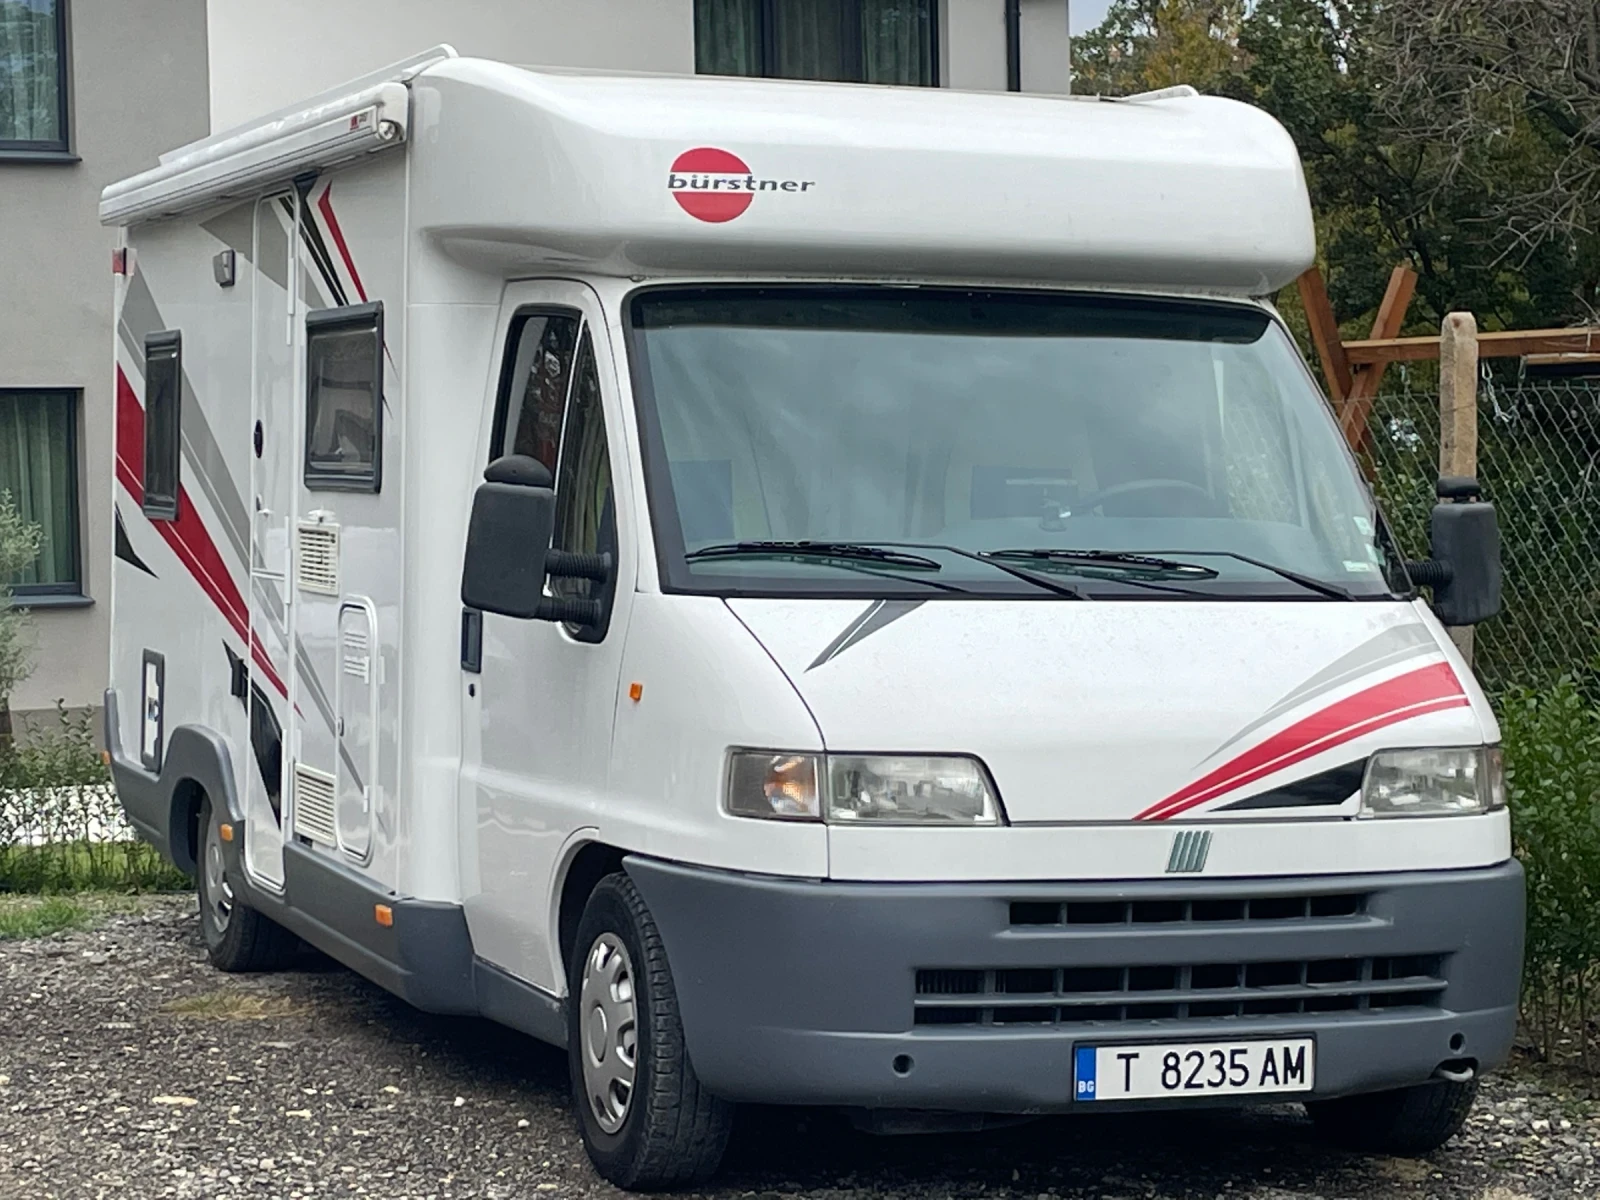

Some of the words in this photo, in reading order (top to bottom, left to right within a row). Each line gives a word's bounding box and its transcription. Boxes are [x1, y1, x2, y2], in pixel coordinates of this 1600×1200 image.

[668, 173, 815, 192] bürstner
[1116, 1052, 1140, 1092] T
[1161, 1048, 1250, 1090] 8235
[1258, 1045, 1306, 1087] AM
[1077, 1080, 1095, 1093] BG
